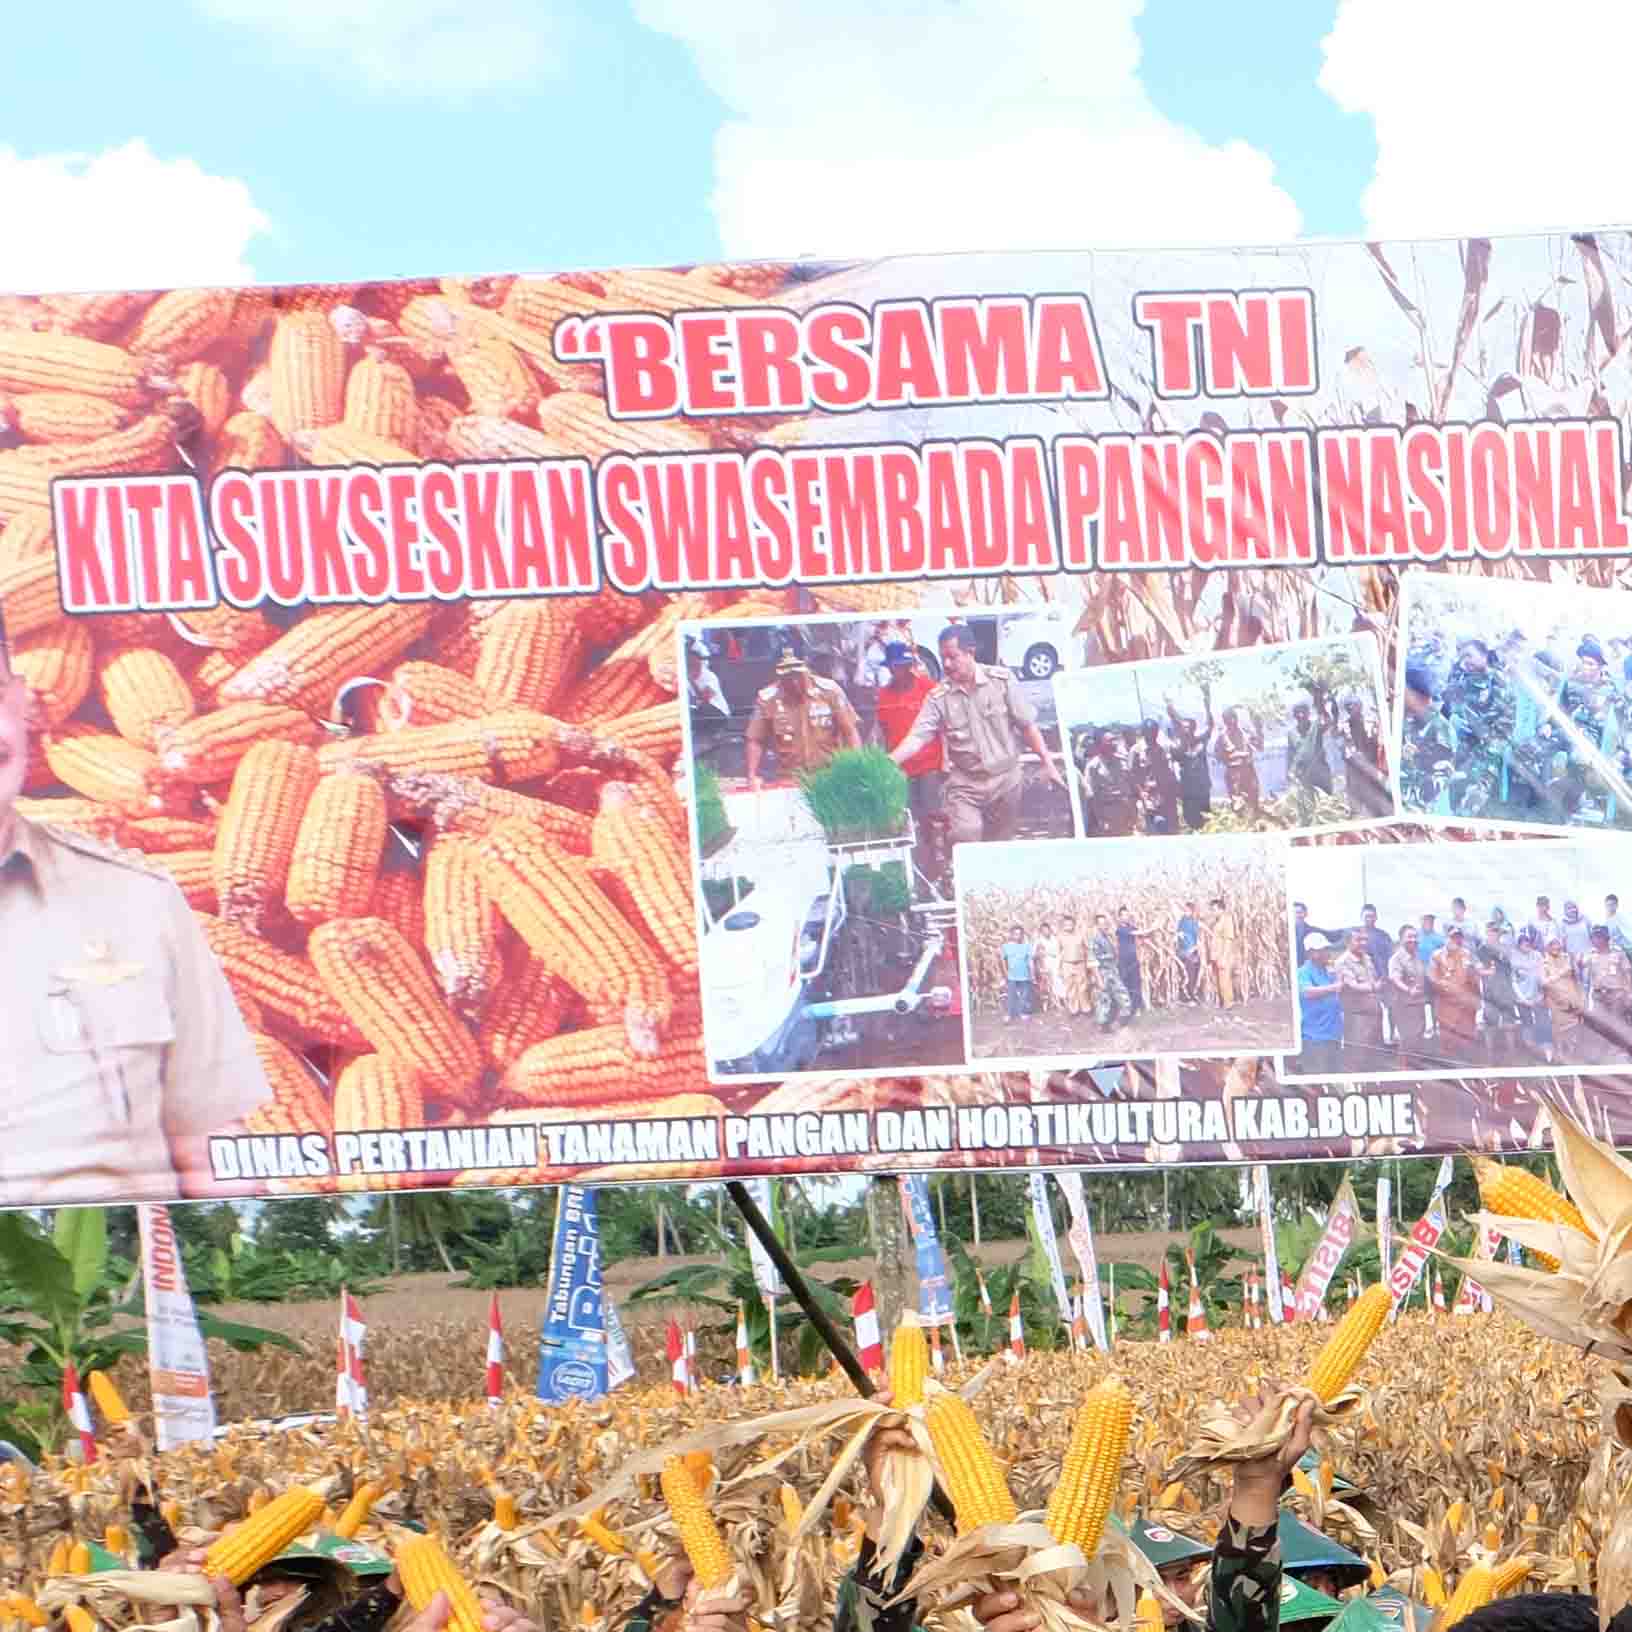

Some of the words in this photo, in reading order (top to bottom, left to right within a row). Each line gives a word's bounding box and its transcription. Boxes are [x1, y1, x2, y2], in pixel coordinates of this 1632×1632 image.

[1142, 298, 1314, 396] TNI
[62, 481, 211, 606] KITA
[217, 463, 598, 602] SUKSESKAN
[608, 440, 1055, 592] SWASEMBADA
[1063, 431, 1314, 571] PANGAN
[1325, 420, 1630, 559] NASIONAL
[211, 1134, 330, 1180] DINAS
[338, 1127, 537, 1176] PERTANIAN
[541, 1117, 720, 1168] TANAMAN
[725, 1110, 870, 1161] PANGAN
[877, 1104, 949, 1153] DAN
[960, 1097, 1225, 1147] HORTIKULTURA
[1233, 1091, 1414, 1140] KAB.BONE
[550, 1229, 578, 1323] Tabungan
